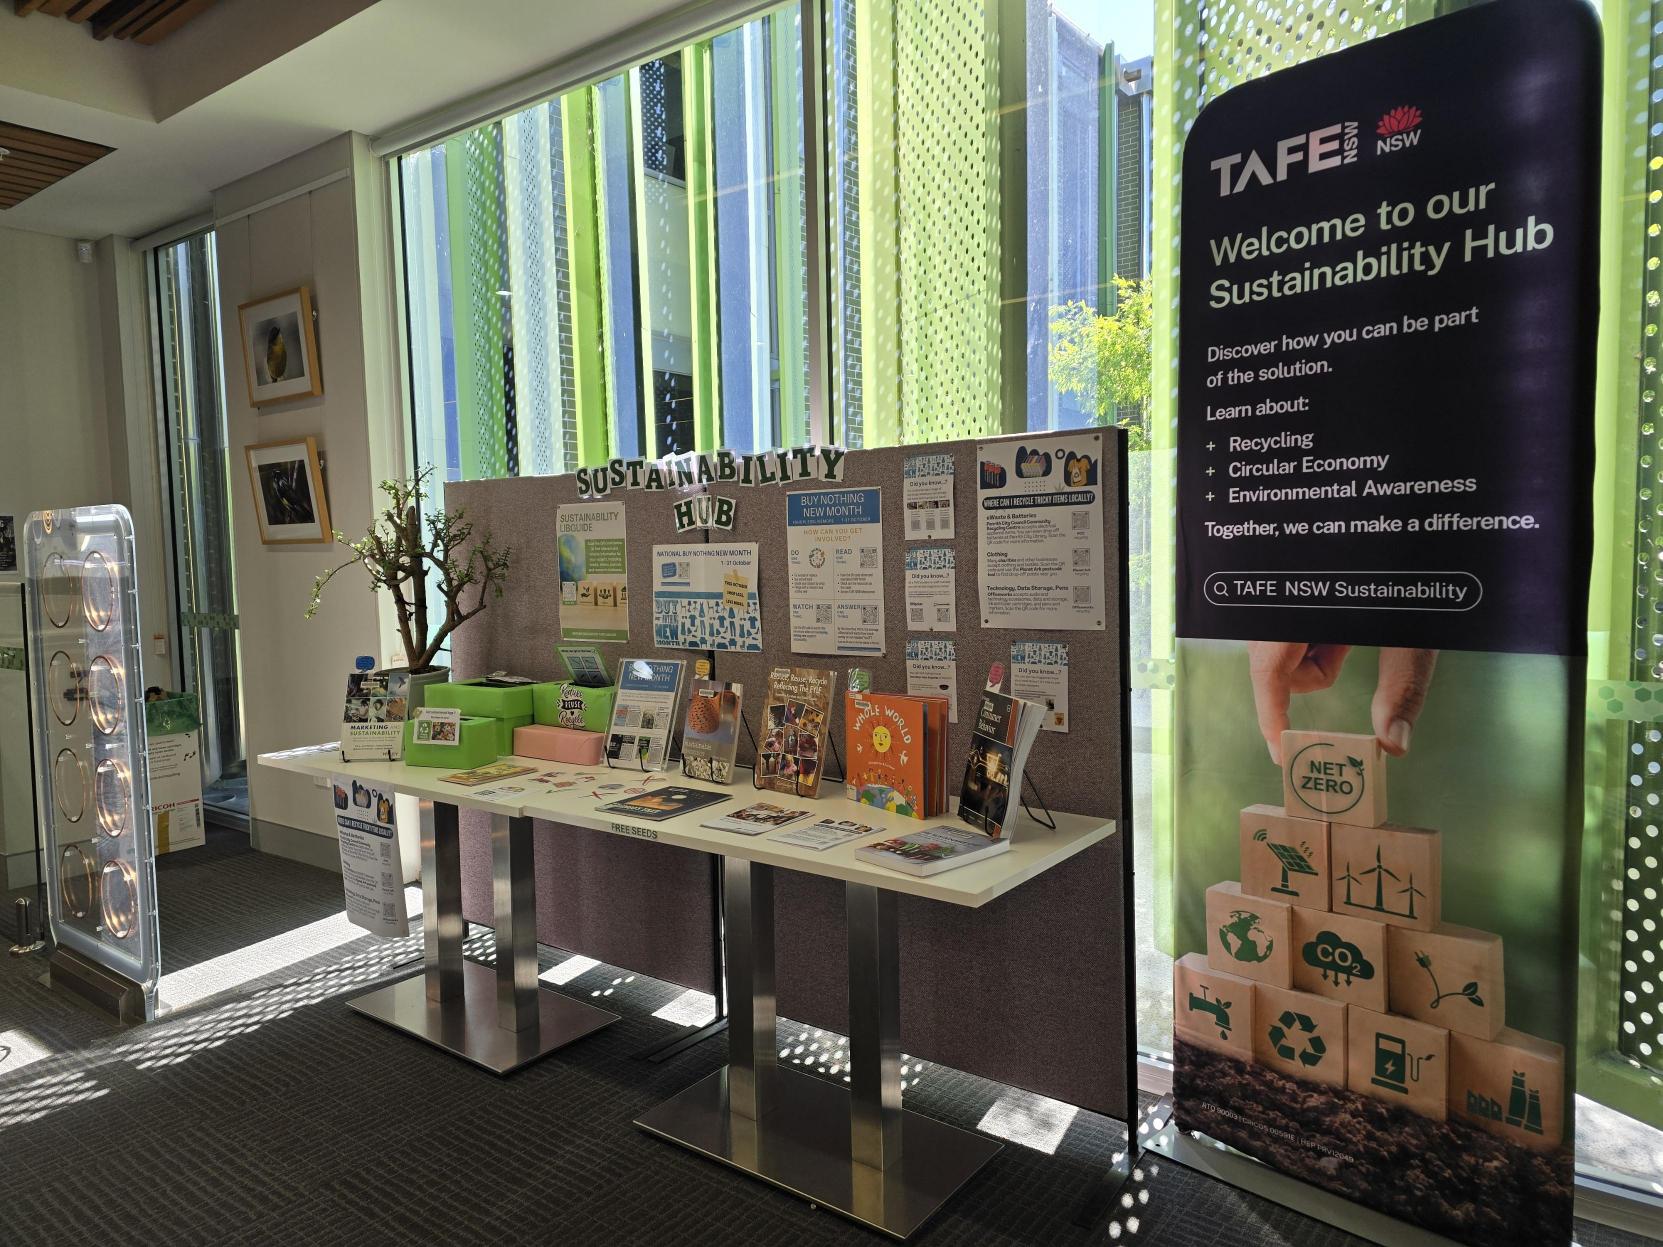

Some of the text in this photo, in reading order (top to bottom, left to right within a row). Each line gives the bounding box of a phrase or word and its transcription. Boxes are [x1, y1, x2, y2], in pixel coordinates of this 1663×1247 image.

[1343, 121, 1359, 164] NSW
[1377, 130, 1421, 155] NSW
[1210, 123, 1342, 197] TAFE
[1210, 182, 1495, 266] Welcome to our
[1209, 215, 1554, 308] Sustainability Hub
[1207, 306, 1479, 362] Discover how you can be part
[1206, 358, 1333, 388] of the solution.
[1206, 396, 1309, 421] Learn about:
[1229, 430, 1314, 453] Recycling
[1229, 452, 1390, 479] Circular Economy
[801, 493, 864, 505] BUY NOTHING
[984, 499, 999, 507] WHERE
[1000, 499, 1010, 507] CAN
[1014, 497, 1034, 505] RECYCLE
[1034, 496, 1051, 505] TRICKY
[1052, 495, 1068, 503] ITEMS
[1068, 493, 1094, 503] LOCALLY?
[1229, 475, 1477, 504] Environmental Awareness
[560, 512, 619, 522] SUSTAINABILITY
[674, 497, 735, 531] HUB
[803, 505, 862, 517] NEW MONTH
[560, 523, 592, 532] LIBGUIDE
[1205, 512, 1540, 541] Together, we can make a difference.
[1233, 580, 1467, 602] TAFE NSW Sustainability
[853, 704, 912, 744] WHOLE WORLD
[1310, 760, 1346, 778] NET
[1301, 776, 1354, 796] ZERO
[151, 802, 175, 812] RICOH
[611, 823, 658, 840] FREE SEEDS
[1201, 1102, 1215, 1113] RTO
[1216, 1106, 1238, 1120] 90003
